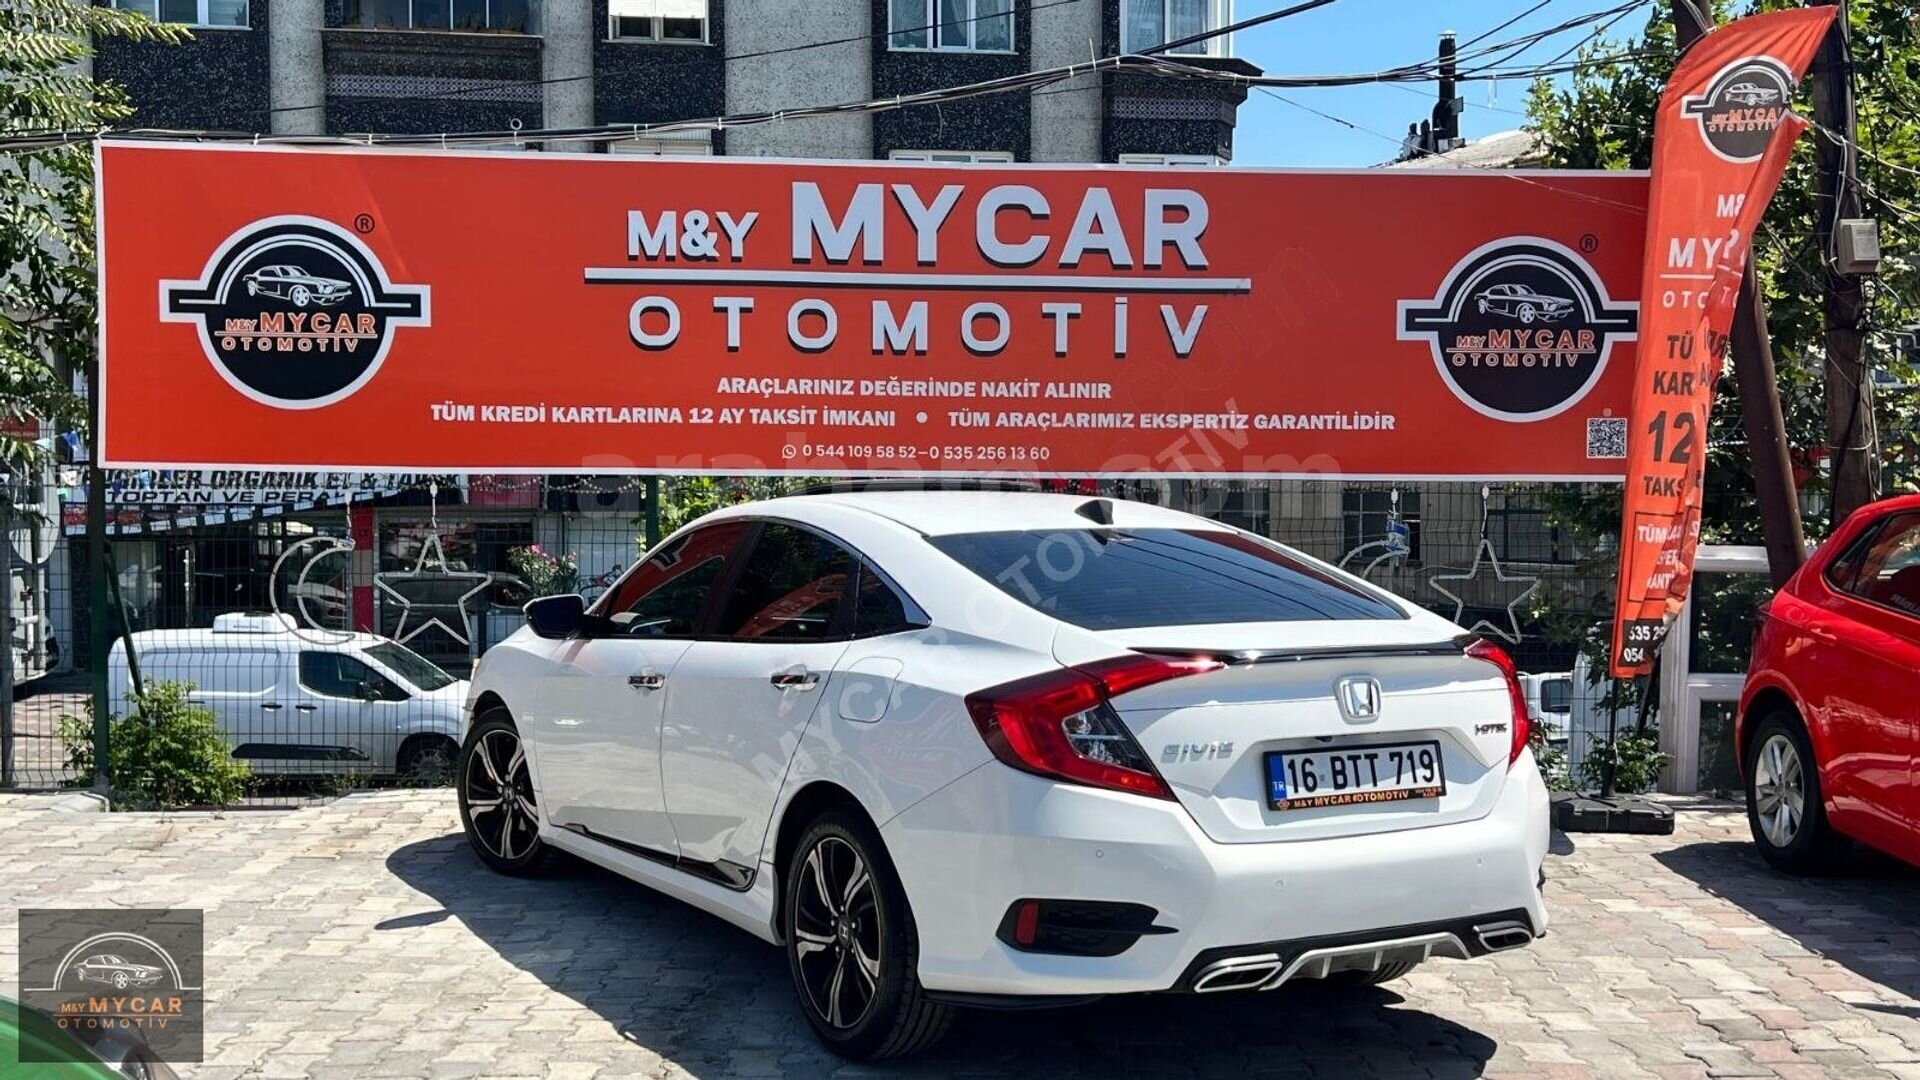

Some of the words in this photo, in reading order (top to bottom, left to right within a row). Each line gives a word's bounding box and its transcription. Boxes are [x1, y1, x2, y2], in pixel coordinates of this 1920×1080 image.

[627, 209, 760, 262] M&Y
[791, 181, 1210, 270] MYCAR
[225, 318, 258, 332] M&Y
[260, 312, 376, 334] MYCAR
[628, 296, 1210, 358] OTOMOTİV
[221, 337, 359, 353] OTOMOTİV
[1456, 335, 1487, 348] M&Y
[1488, 329, 1596, 349] MYCAR
[1452, 353, 1579, 368] OTOMOTİV
[717, 377, 854, 399] ARAÇLARINIZ
[860, 376, 976, 398] DEĞERİNDE
[981, 378, 1041, 398] NAKİT
[1044, 382, 1112, 399] ALINIR
[431, 400, 475, 422] TÜM
[481, 402, 546, 423] KREDİ
[552, 406, 683, 424] KARTLARINA
[688, 407, 714, 424] 12
[718, 407, 745, 424] AY
[749, 405, 818, 425] TAKSİT
[822, 405, 896, 426] İMKANI
[947, 407, 990, 427] TÜM
[995, 411, 1135, 431] ARAÇLARIMIZ
[1139, 410, 1249, 430] EKSPERTİZ
[1253, 411, 1396, 430] GARANTİLİDİR
[802, 444, 813, 457] 0
[816, 444, 845, 457] 544
[848, 445, 873, 458] 109
[876, 445, 895, 459] 58
[943, 446, 974, 460] 535
[977, 446, 1007, 460] 256
[1010, 446, 1026, 460] 13
[1029, 446, 1050, 460] 60
[107, 490, 212, 503] TOPTAN
[223, 491, 256, 503] VE
[1272, 780, 1286, 792] TR
[1288, 757, 1318, 794] 16
[1330, 752, 1379, 790] BTT
[1389, 749, 1435, 784] 719
[1315, 795, 1351, 806] MYCAR
